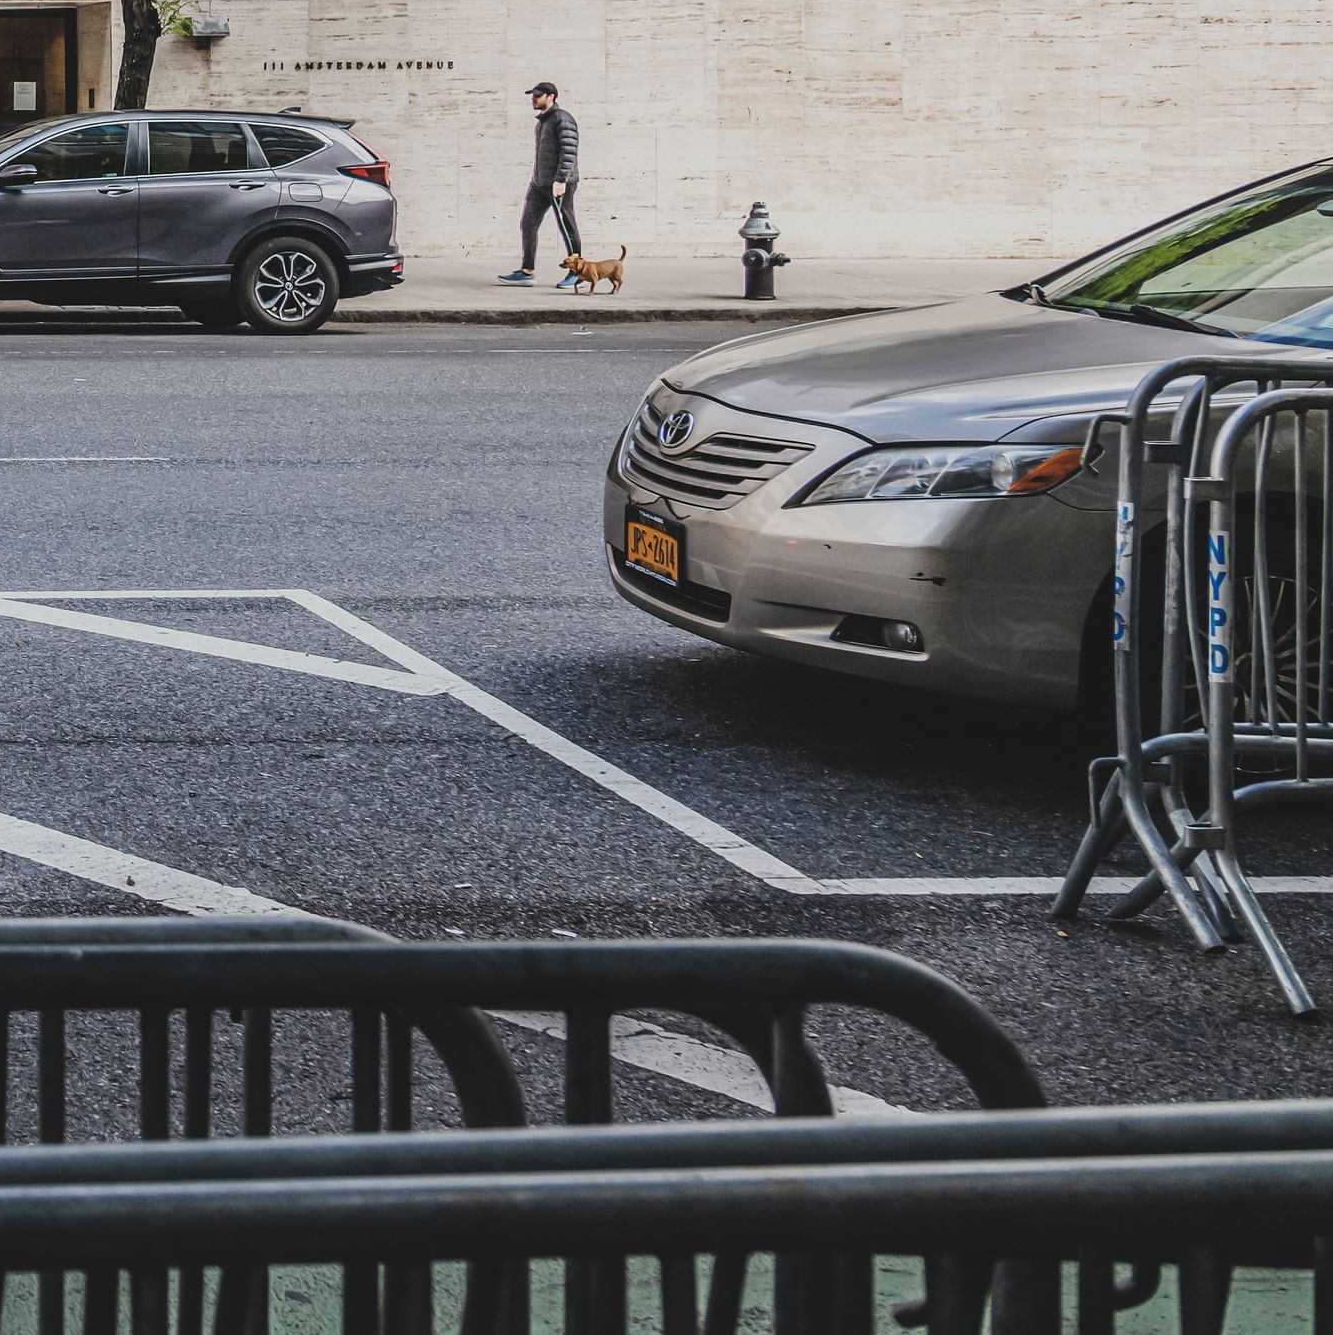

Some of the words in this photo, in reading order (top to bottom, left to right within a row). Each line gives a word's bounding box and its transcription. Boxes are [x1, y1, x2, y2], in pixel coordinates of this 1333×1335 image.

[294, 61, 388, 71] AMSTERDAM
[396, 61, 455, 70] AVENUE
[1208, 534, 1229, 674] NYPD
